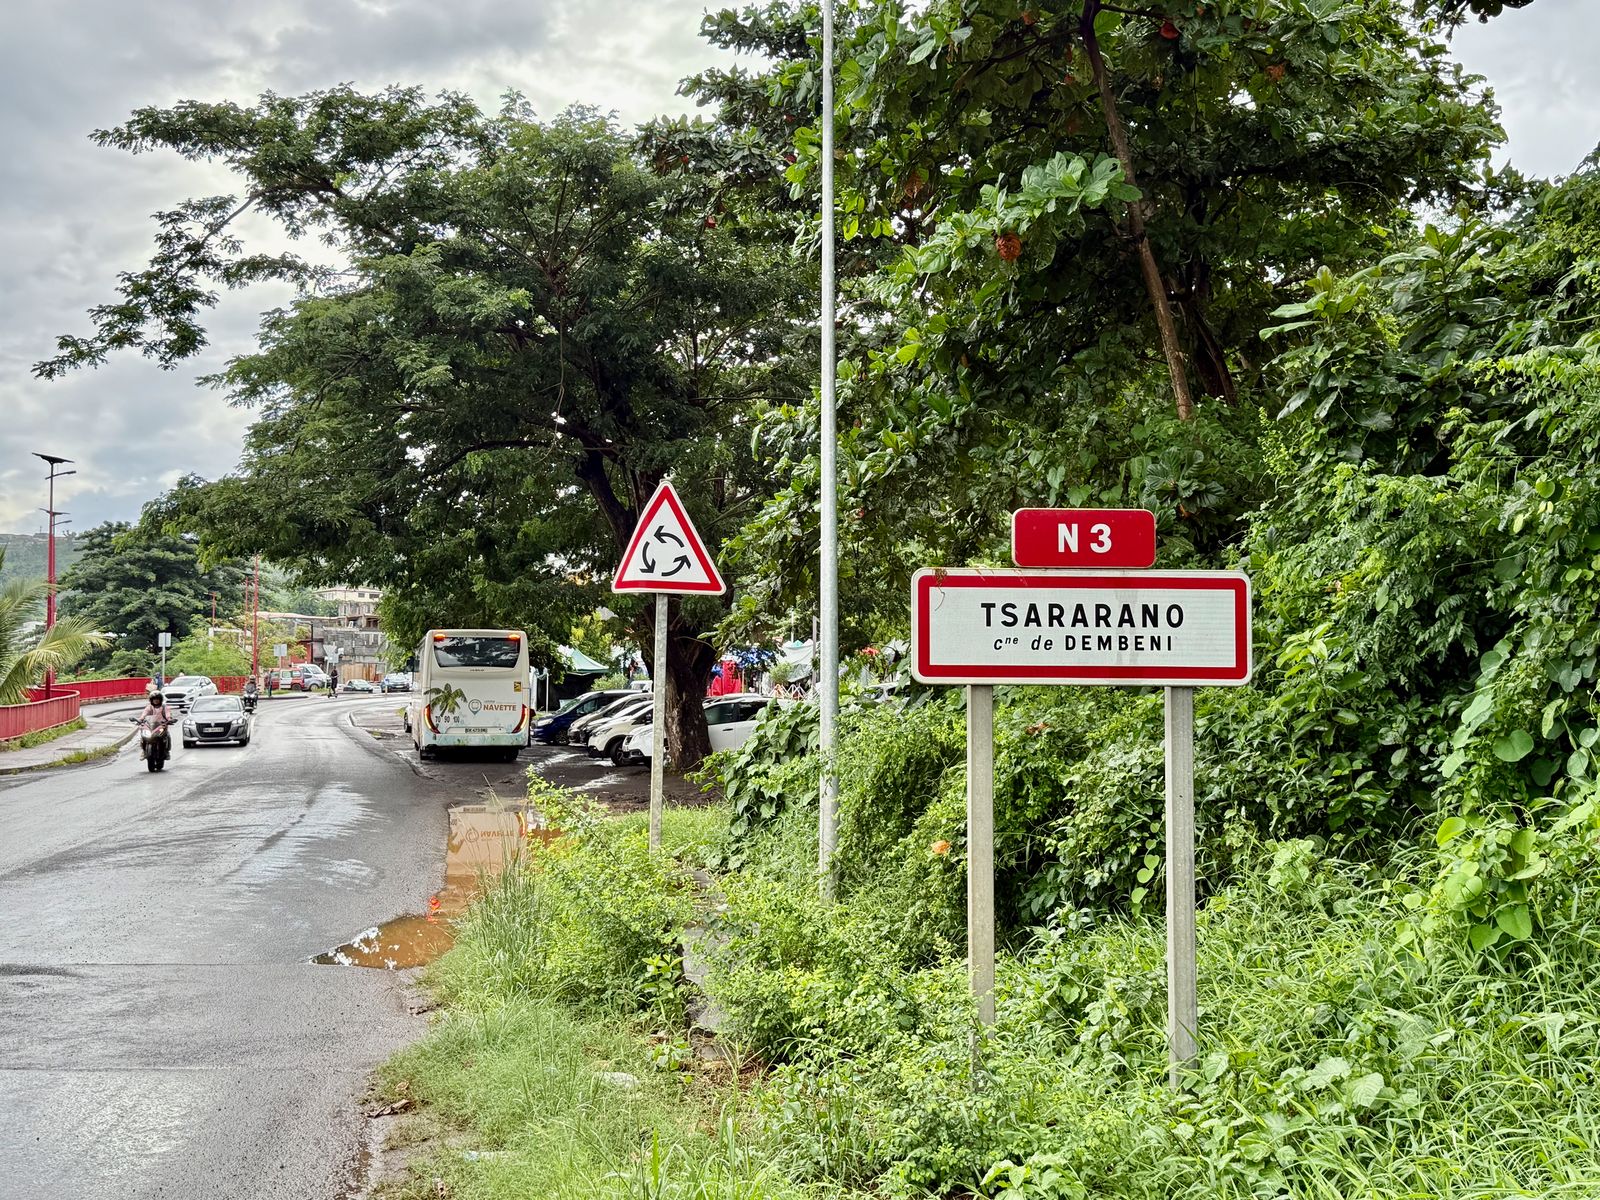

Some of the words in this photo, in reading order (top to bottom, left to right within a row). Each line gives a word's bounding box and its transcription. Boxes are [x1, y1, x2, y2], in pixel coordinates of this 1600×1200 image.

[1057, 523, 1079, 553] N
[1089, 523, 1112, 553] 3
[980, 603, 1184, 628] TSARARANO
[1031, 635, 1053, 651] de
[1065, 635, 1172, 651] DEMBENI
